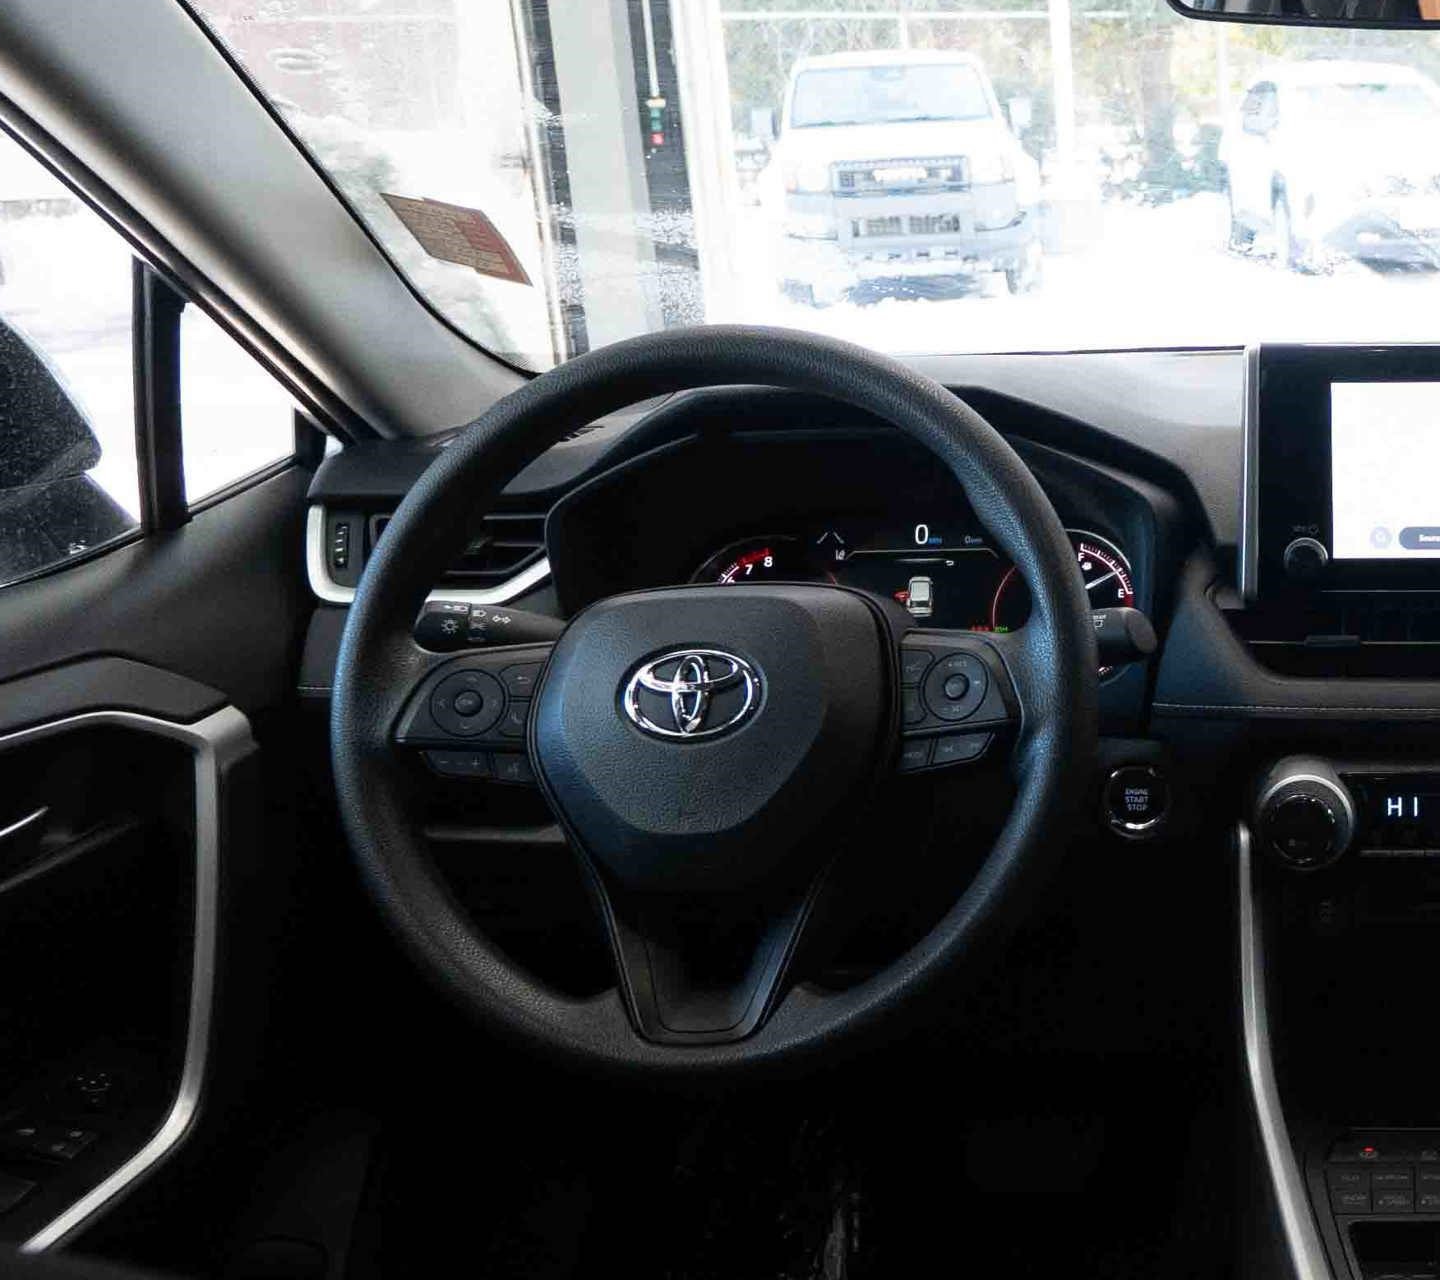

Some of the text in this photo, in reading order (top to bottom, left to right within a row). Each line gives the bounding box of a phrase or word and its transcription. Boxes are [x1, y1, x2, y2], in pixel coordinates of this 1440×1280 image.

[914, 523, 929, 545] 0
[763, 556, 773, 568] 8
[1077, 552, 1085, 562] F
[744, 563, 754, 575] 7
[1118, 588, 1125, 598] E
[1126, 803, 1148, 811] STOP
[1387, 796, 1418, 817] HI
